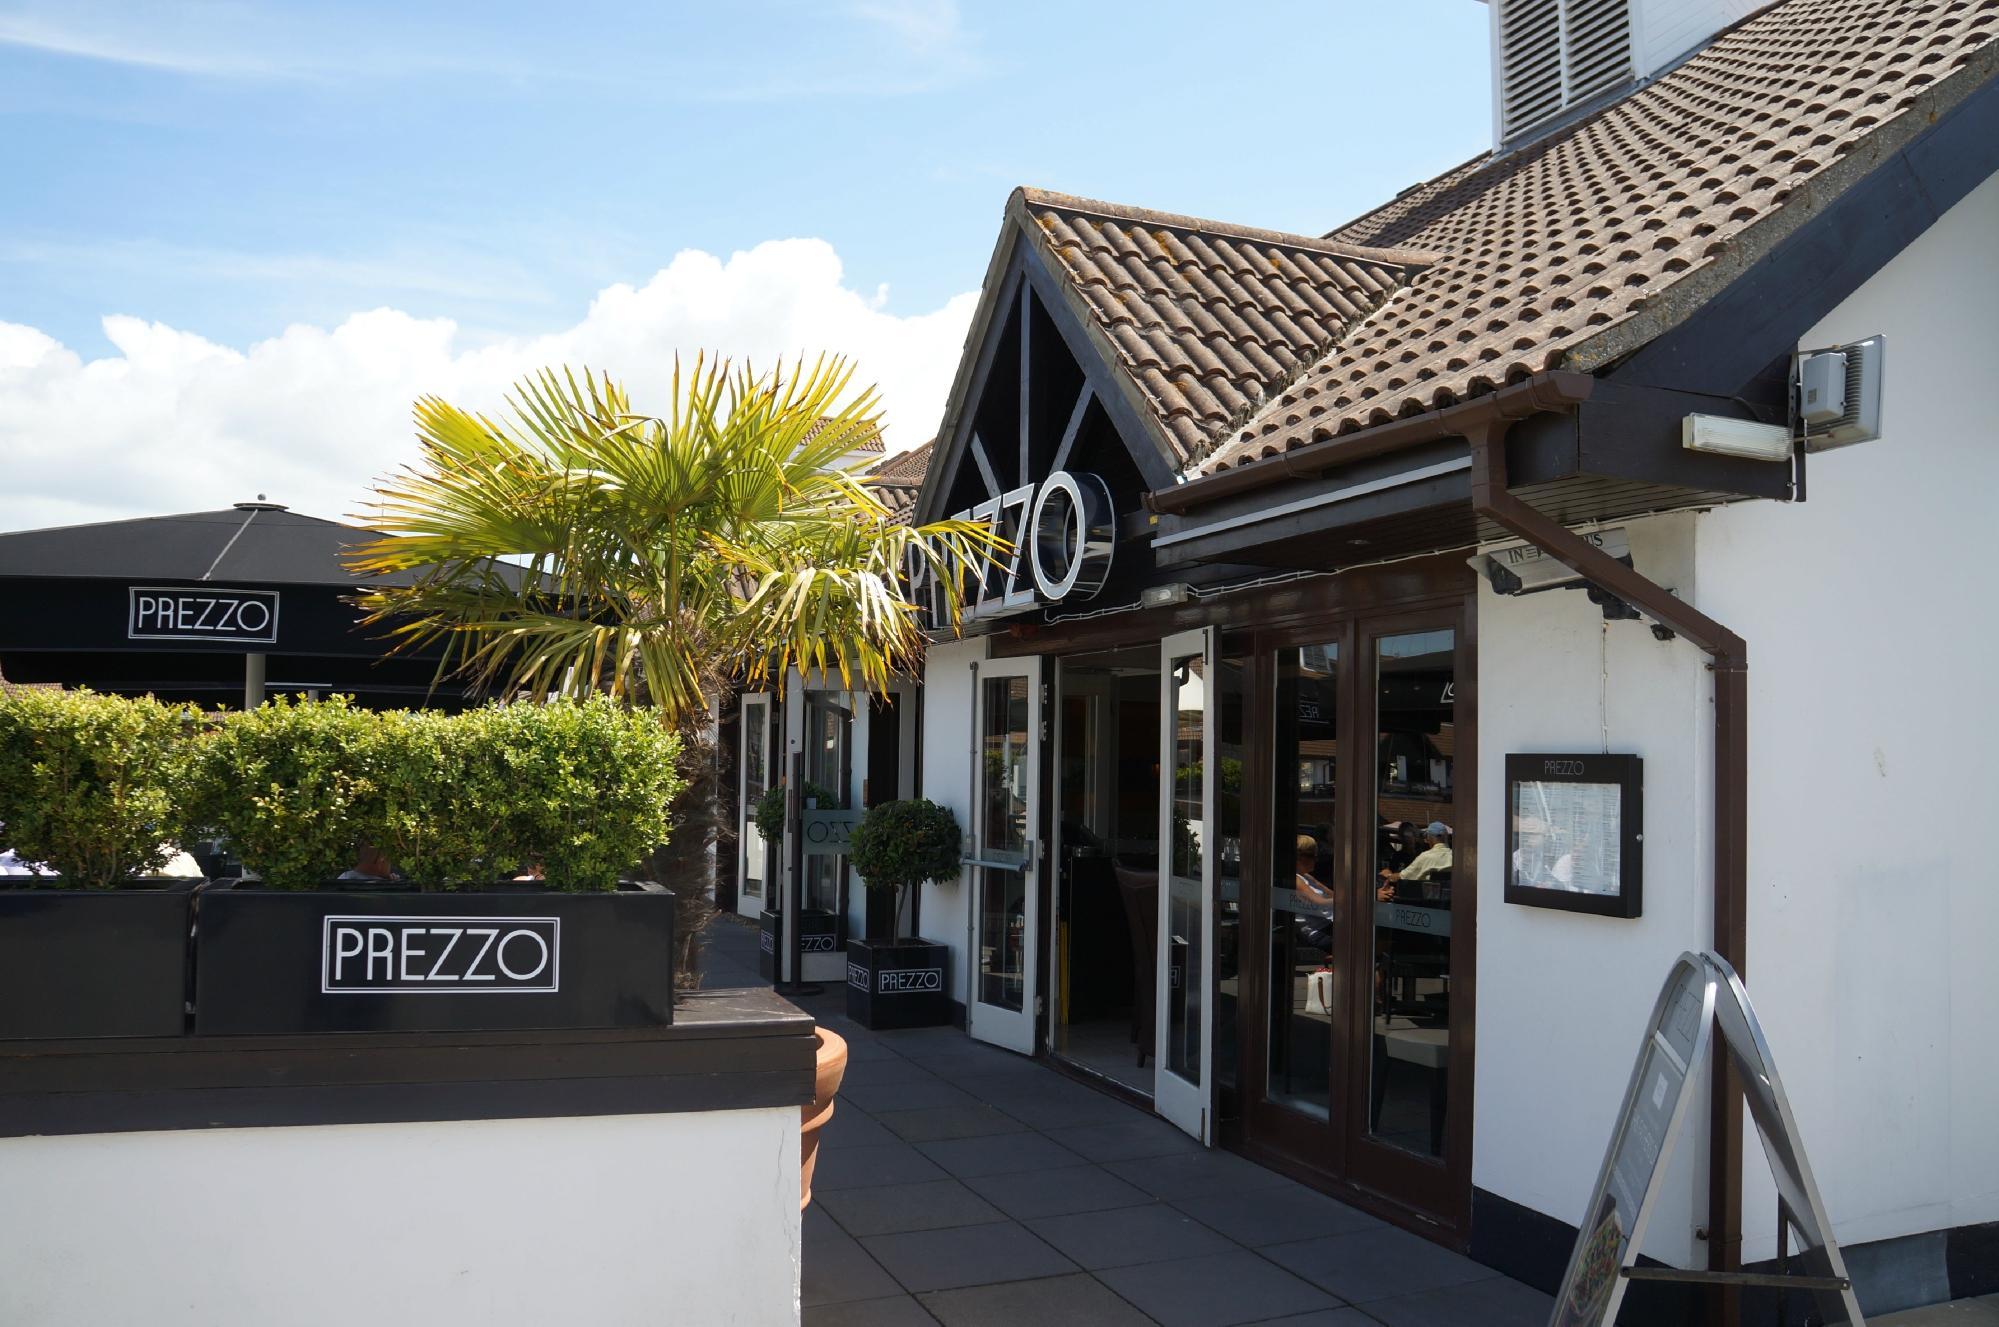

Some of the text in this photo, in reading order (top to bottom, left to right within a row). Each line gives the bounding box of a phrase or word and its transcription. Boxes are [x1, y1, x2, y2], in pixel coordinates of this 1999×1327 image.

[137, 597, 270, 632] PREZZO
[1544, 760, 1585, 776] PREZZO
[1395, 909, 1432, 928] PREZZO
[800, 936, 834, 951] EZZO
[335, 927, 548, 981] PREZZO
[881, 972, 939, 990] PREZZO
